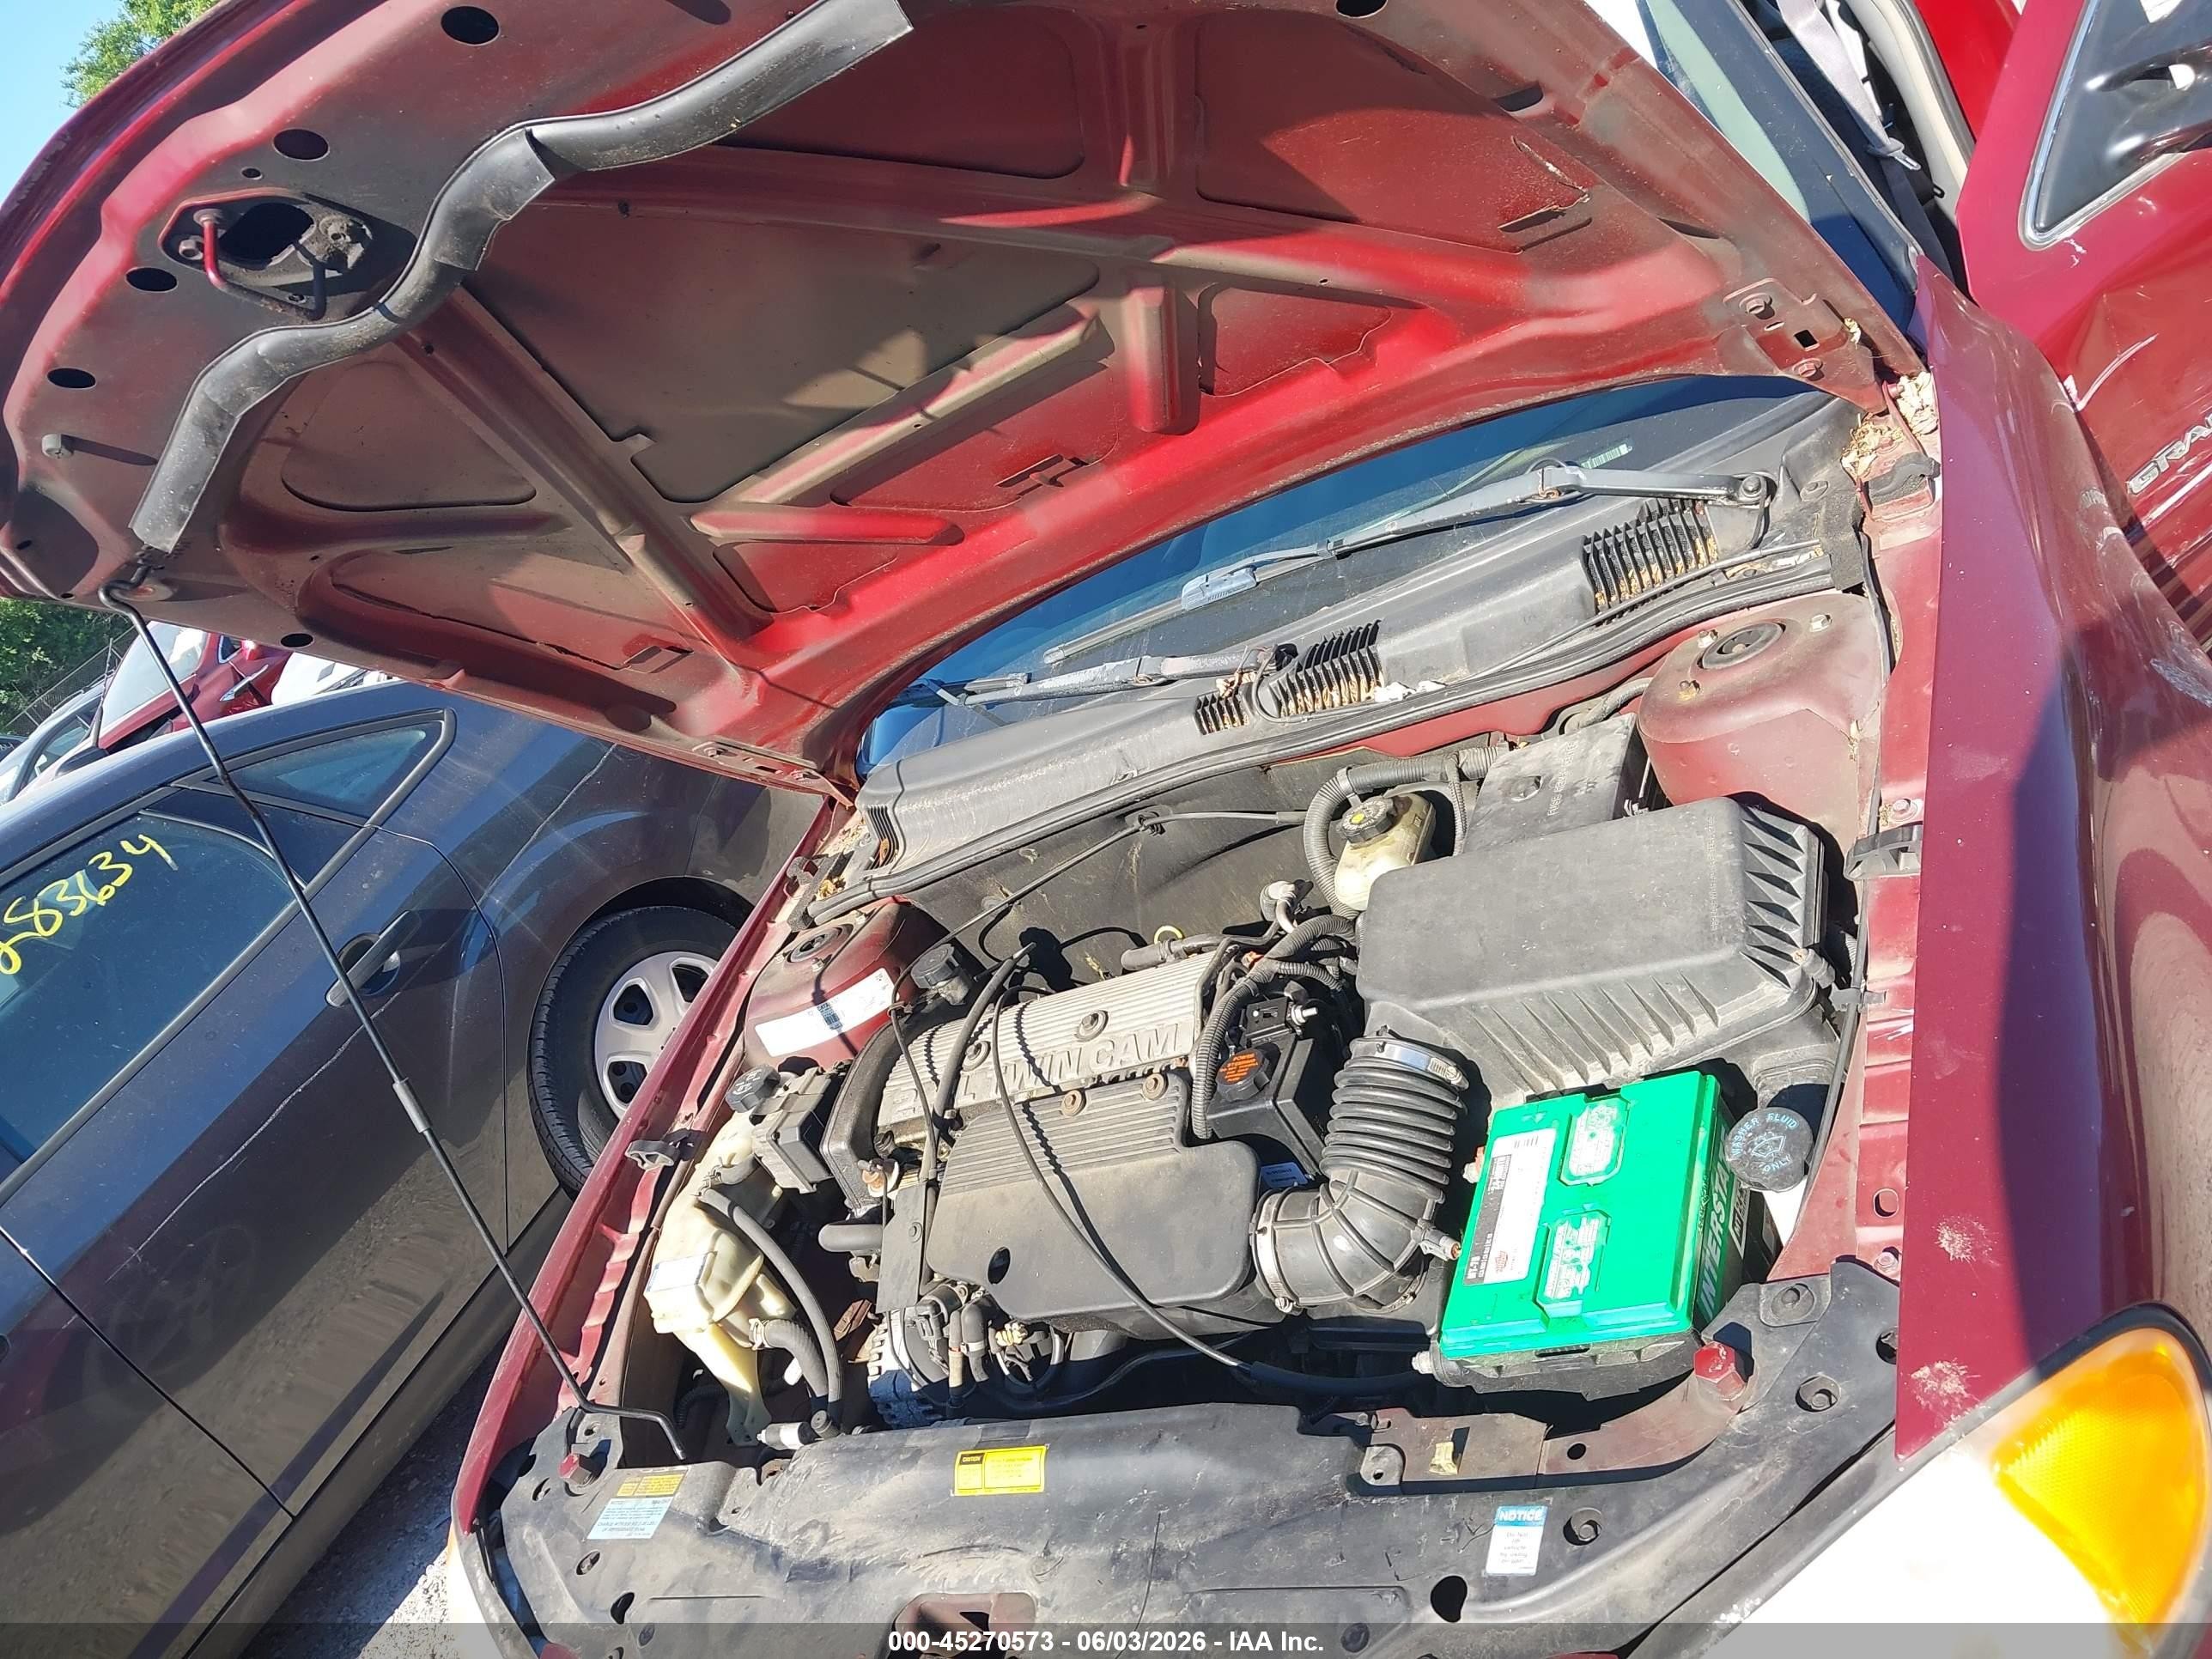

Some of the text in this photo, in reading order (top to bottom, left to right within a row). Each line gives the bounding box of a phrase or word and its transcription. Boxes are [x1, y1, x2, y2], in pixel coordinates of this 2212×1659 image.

[2124, 413, 2212, 495] GRA
[892, 1073, 977, 1114] 2L
[1092, 1020, 1181, 1070] CAM
[1730, 1112, 1798, 1157] WASHER FLUID
[1763, 1153, 1792, 1173] ONLY
[1498, 1510, 1542, 1522] NOTICE
